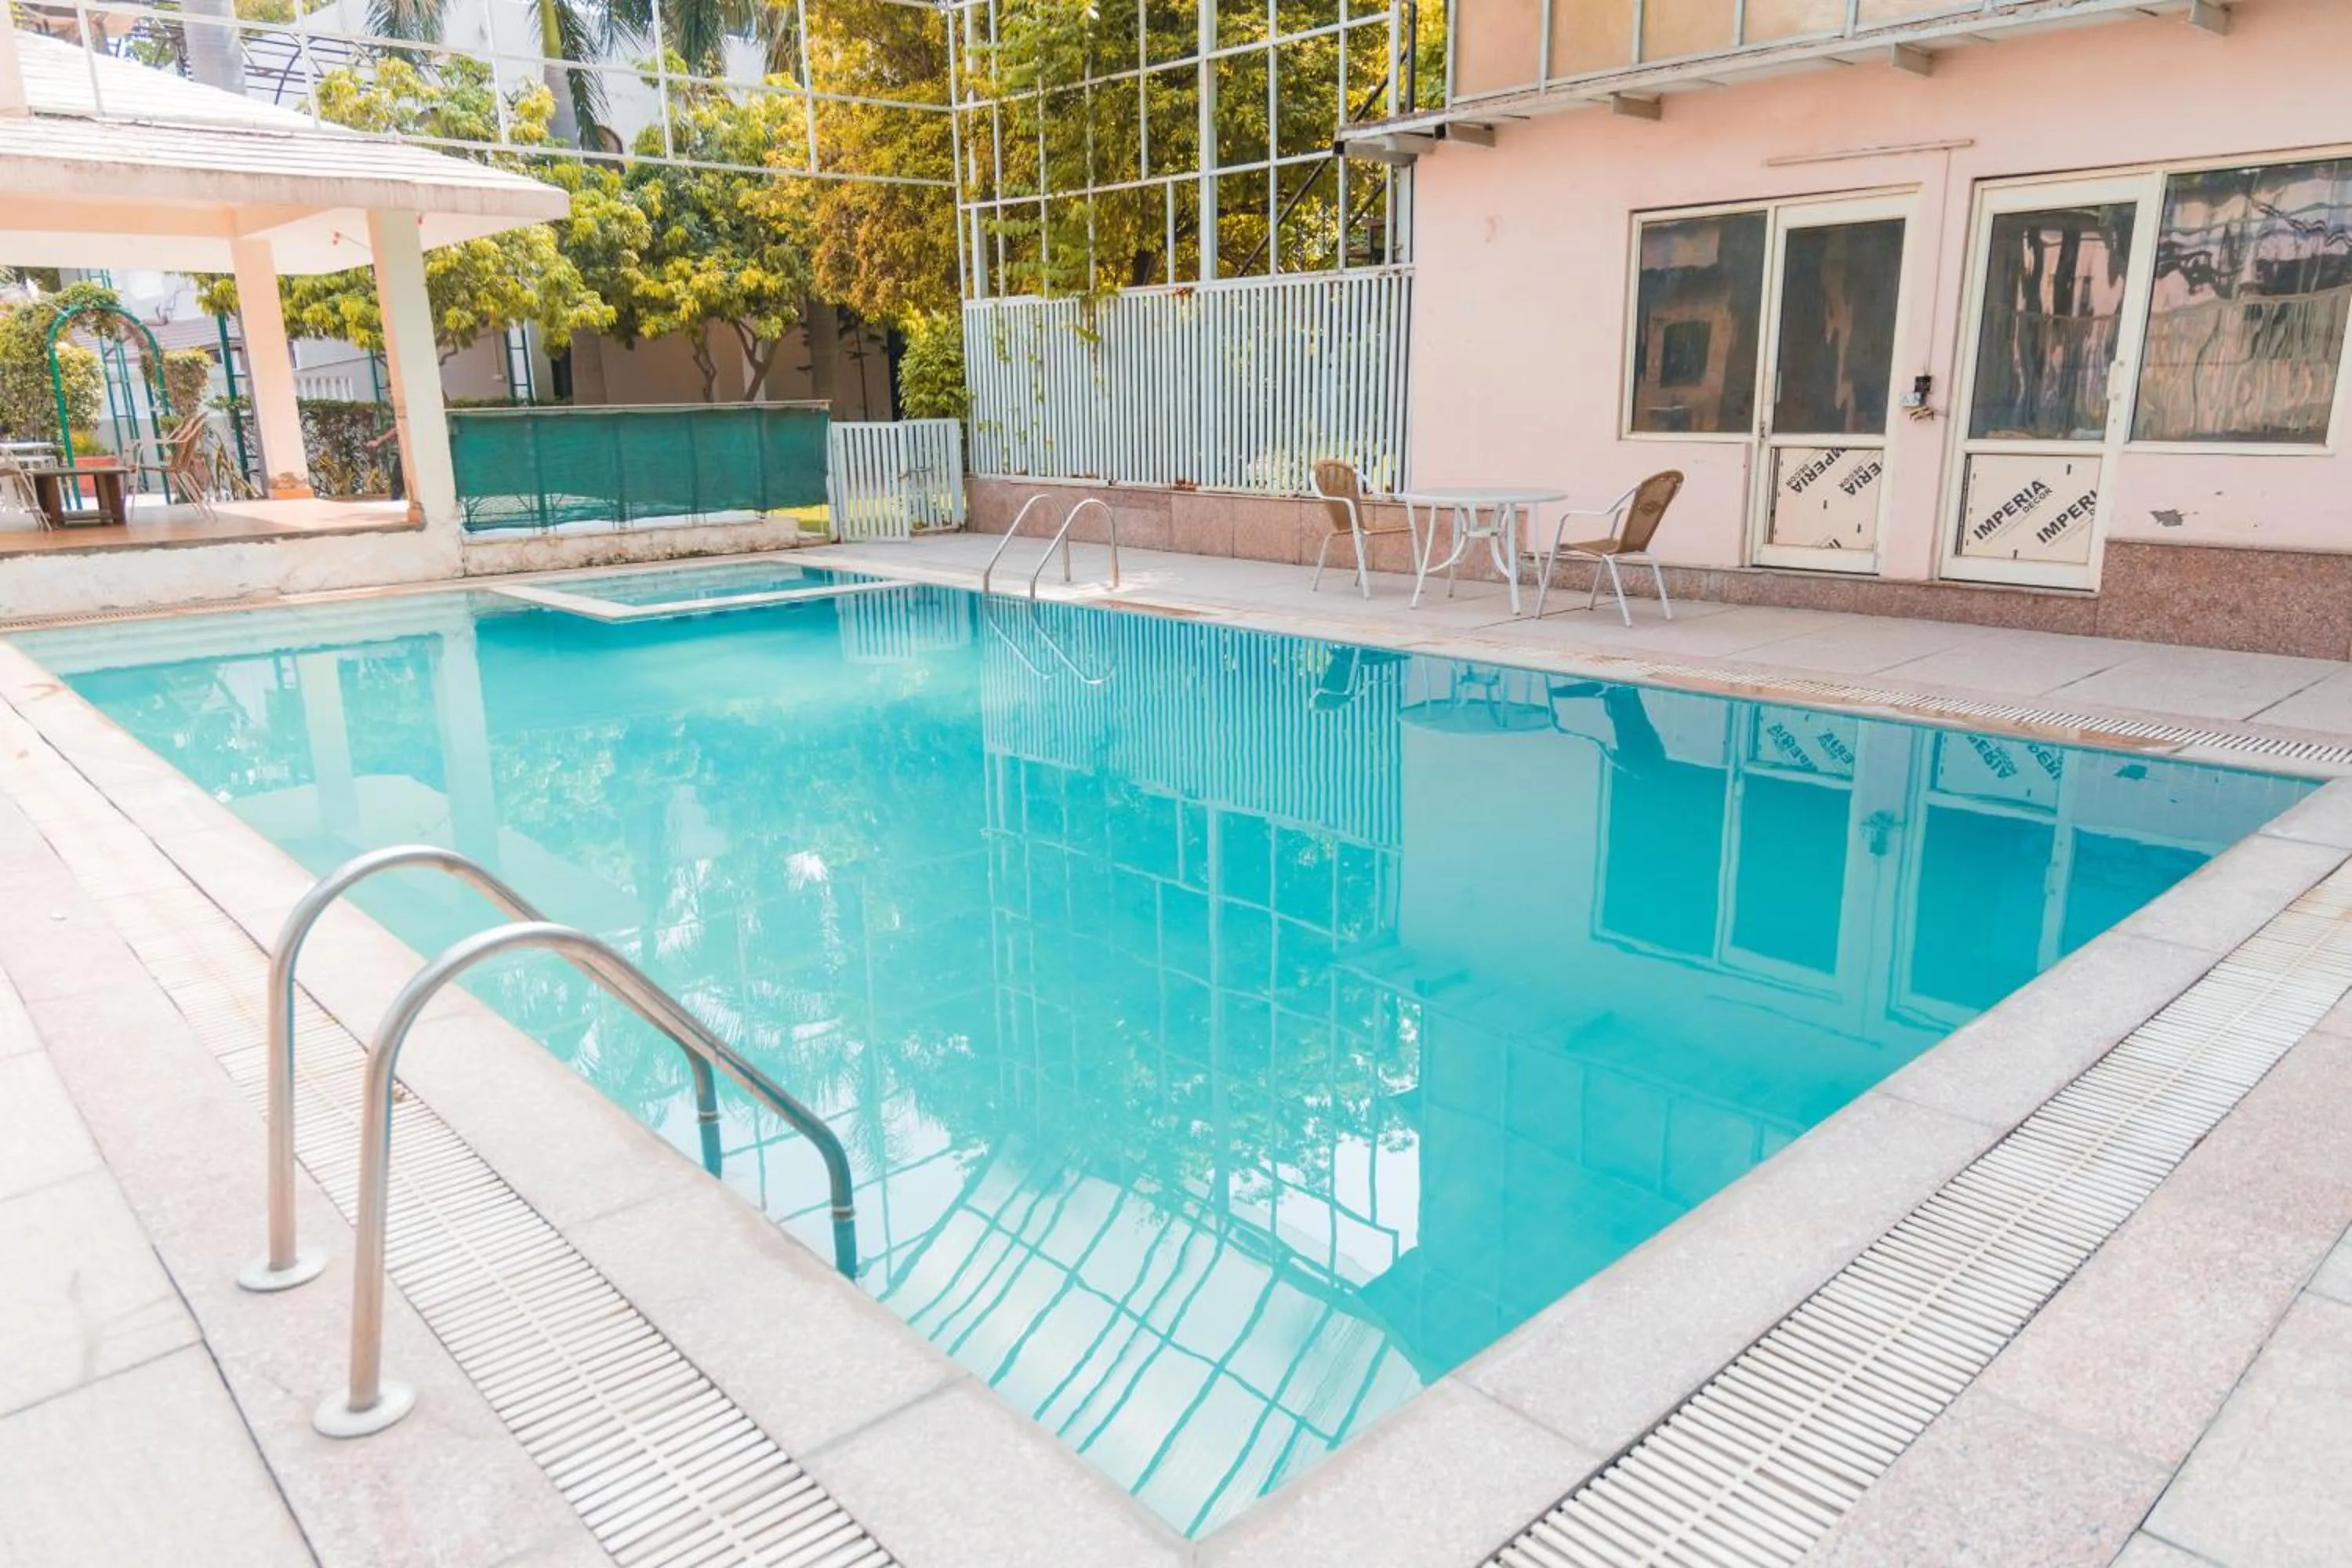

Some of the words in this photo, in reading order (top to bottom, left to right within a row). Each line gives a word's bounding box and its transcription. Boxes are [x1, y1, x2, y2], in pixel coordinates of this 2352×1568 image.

[1838, 465, 1864, 488] DECOR
[1843, 462, 1882, 495] ERIA
[1973, 480, 2046, 540] IMPERIA
[2022, 487, 2053, 514] DECOR
